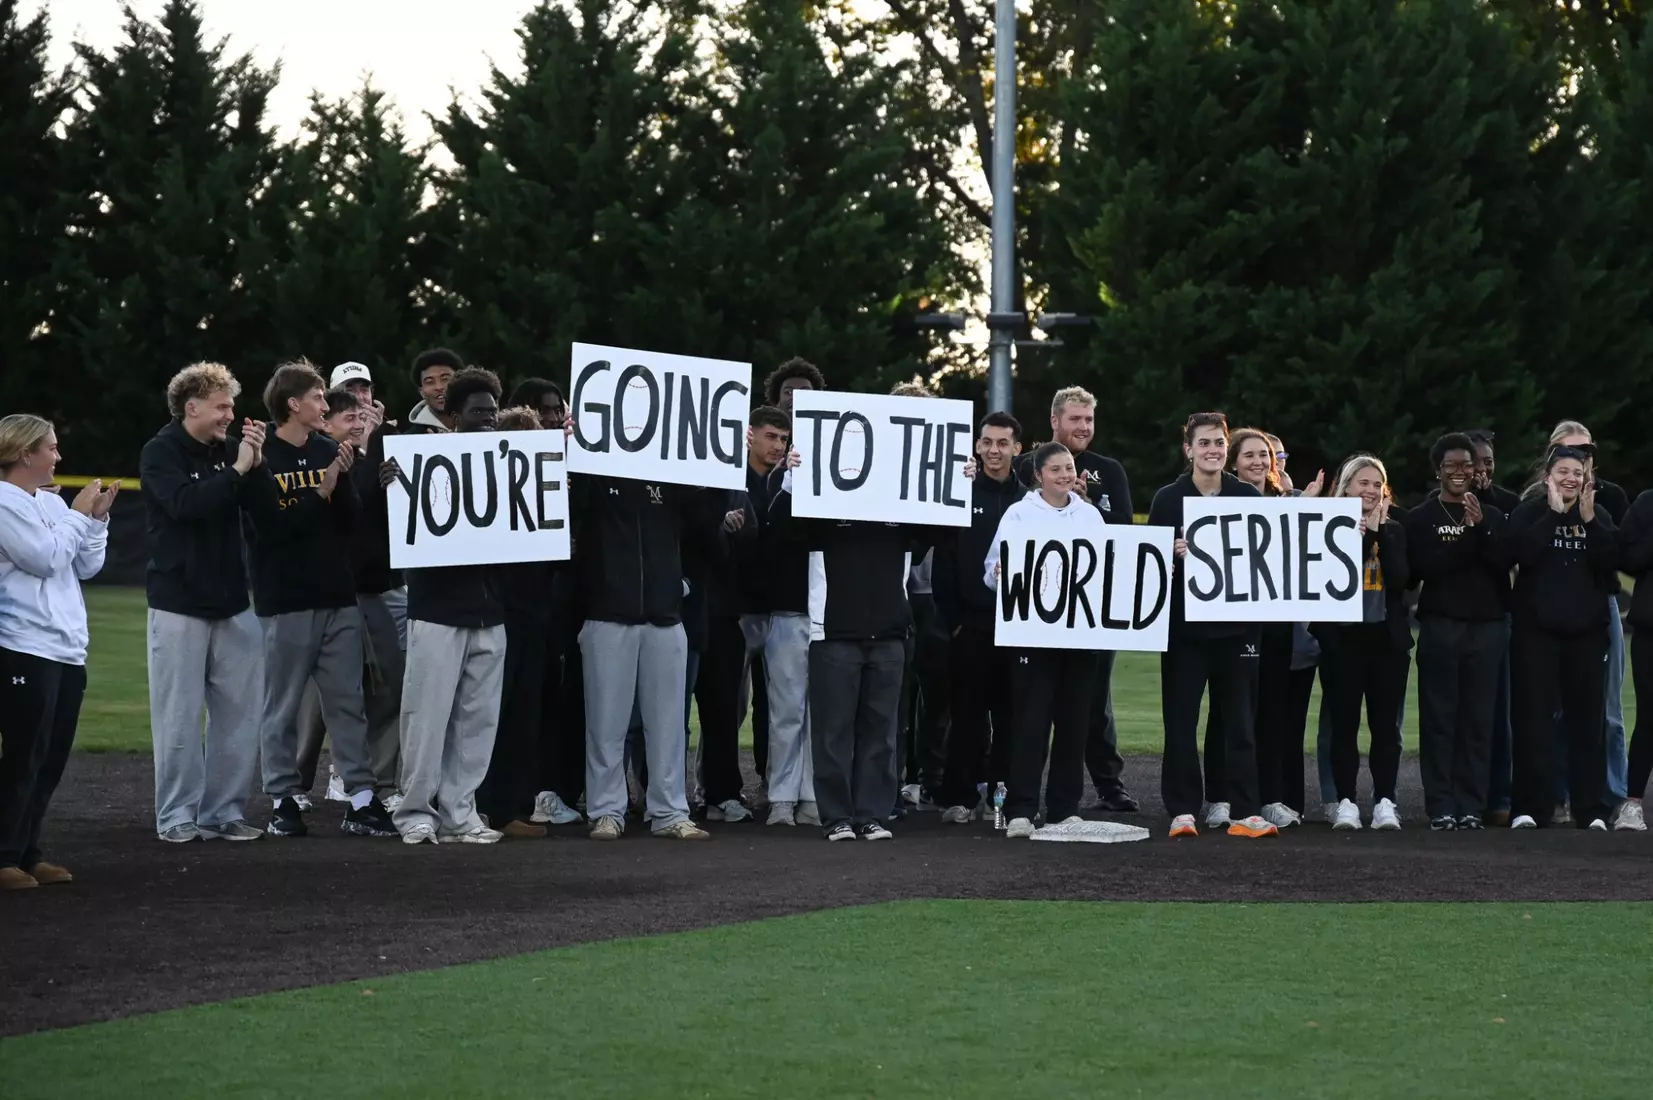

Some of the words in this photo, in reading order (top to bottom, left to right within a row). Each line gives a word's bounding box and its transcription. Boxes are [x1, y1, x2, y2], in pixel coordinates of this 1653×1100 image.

[572, 360, 748, 468] GOING
[795, 410, 874, 497] TO
[889, 416, 971, 508] THE
[391, 439, 564, 545] YOU'RE
[999, 539, 1168, 631] WORLD
[1185, 513, 1359, 602] SERIES
